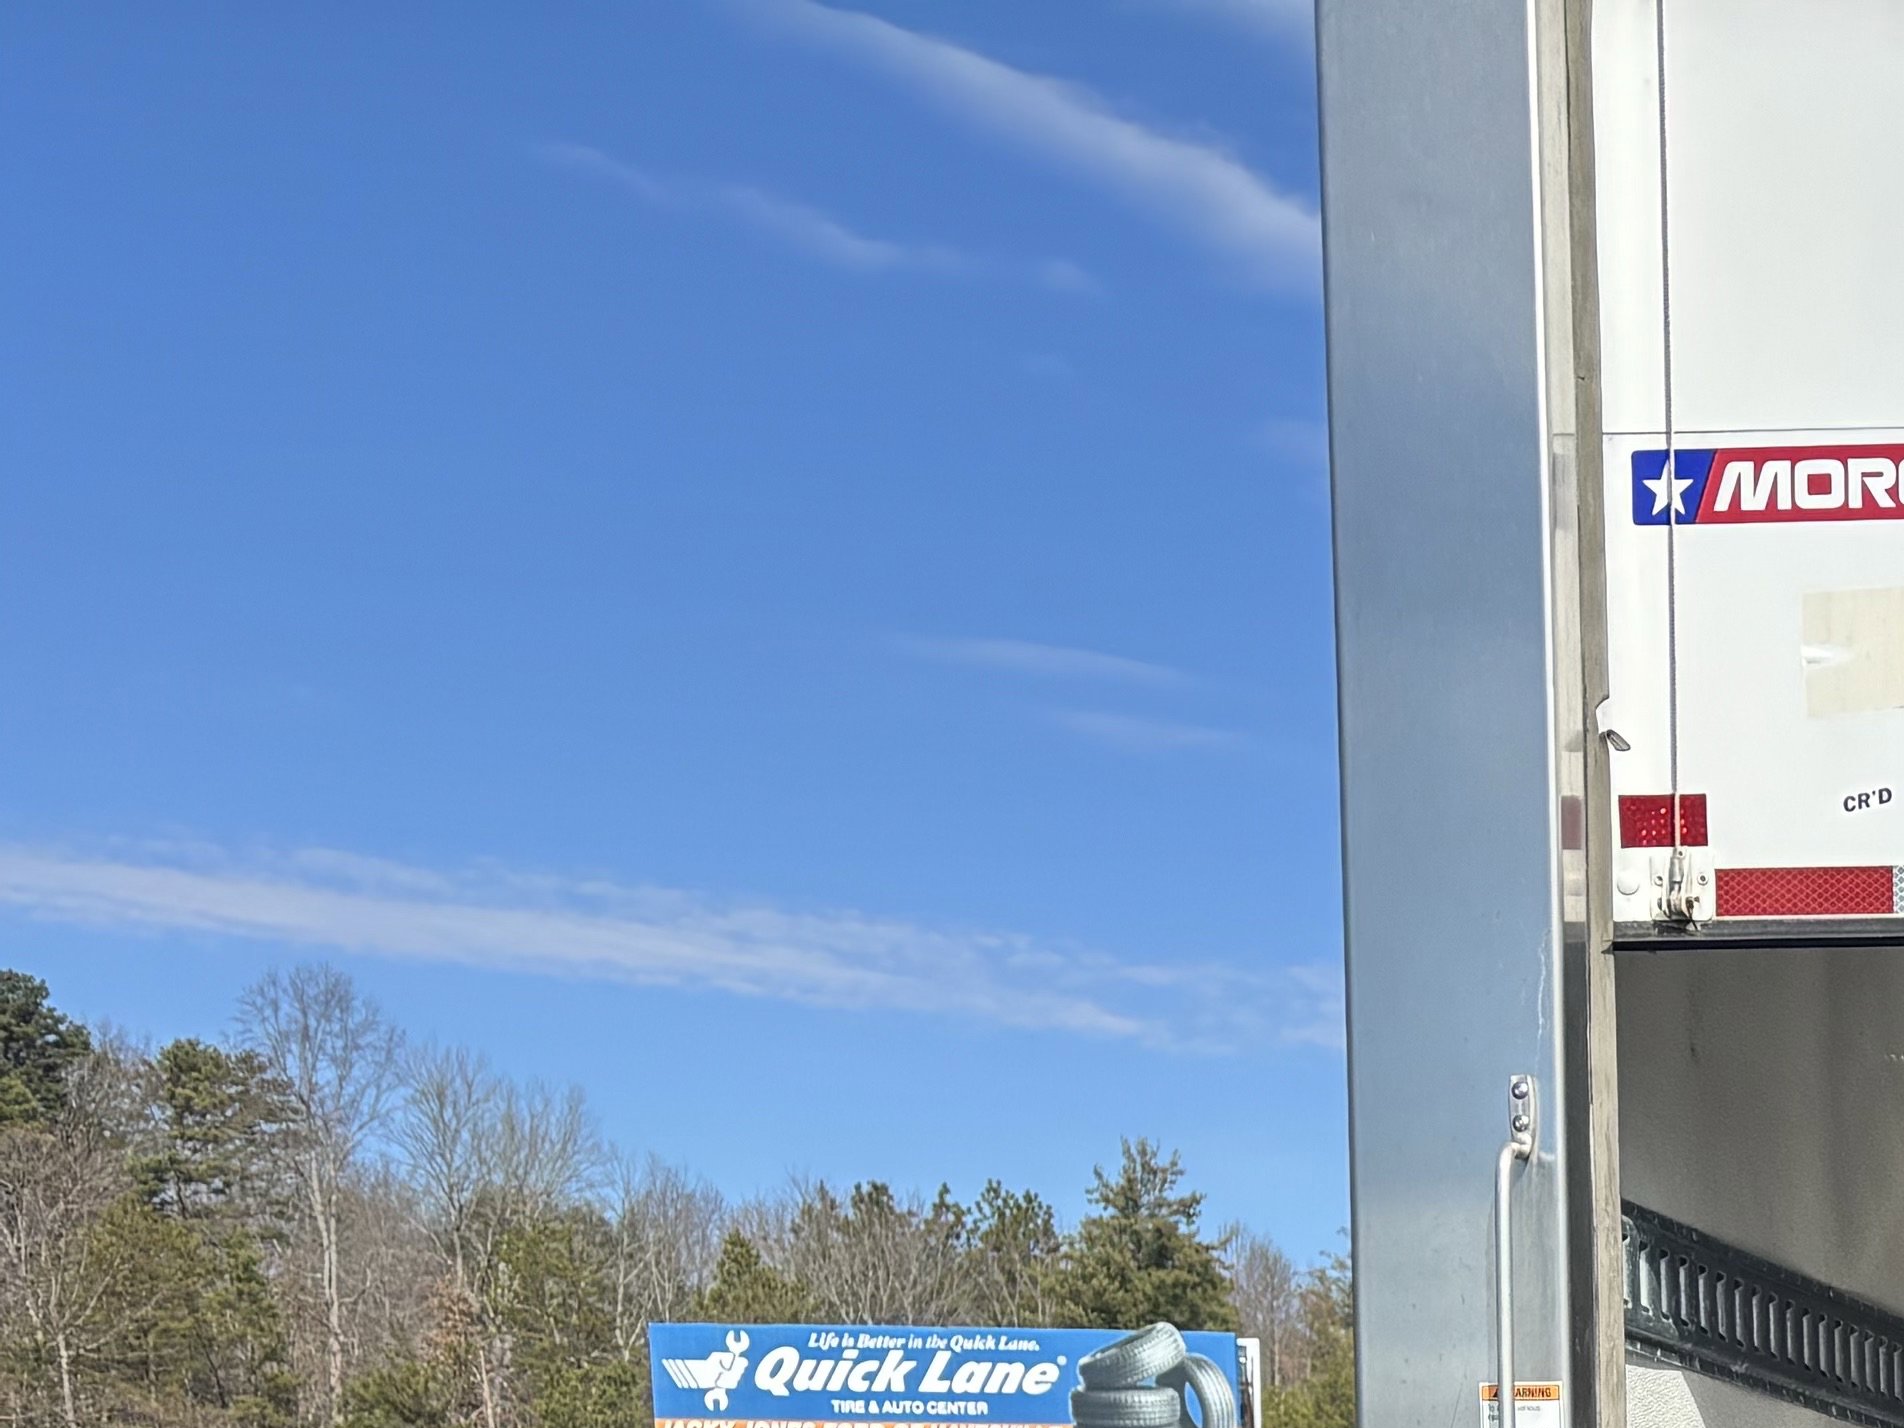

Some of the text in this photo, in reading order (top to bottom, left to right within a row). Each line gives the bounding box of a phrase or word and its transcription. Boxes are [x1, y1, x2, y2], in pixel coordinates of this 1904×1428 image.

[1843, 788, 1893, 813] CR'D
[808, 1332, 839, 1350] Life
[841, 1333, 855, 1348] is
[857, 1333, 906, 1349] Better
[908, 1334, 922, 1349] in
[926, 1334, 948, 1349] the
[950, 1334, 996, 1353] Quick
[754, 1346, 1060, 1396] Quick Lane
[831, 1400, 989, 1415] TIRE & AUTO CENTER
